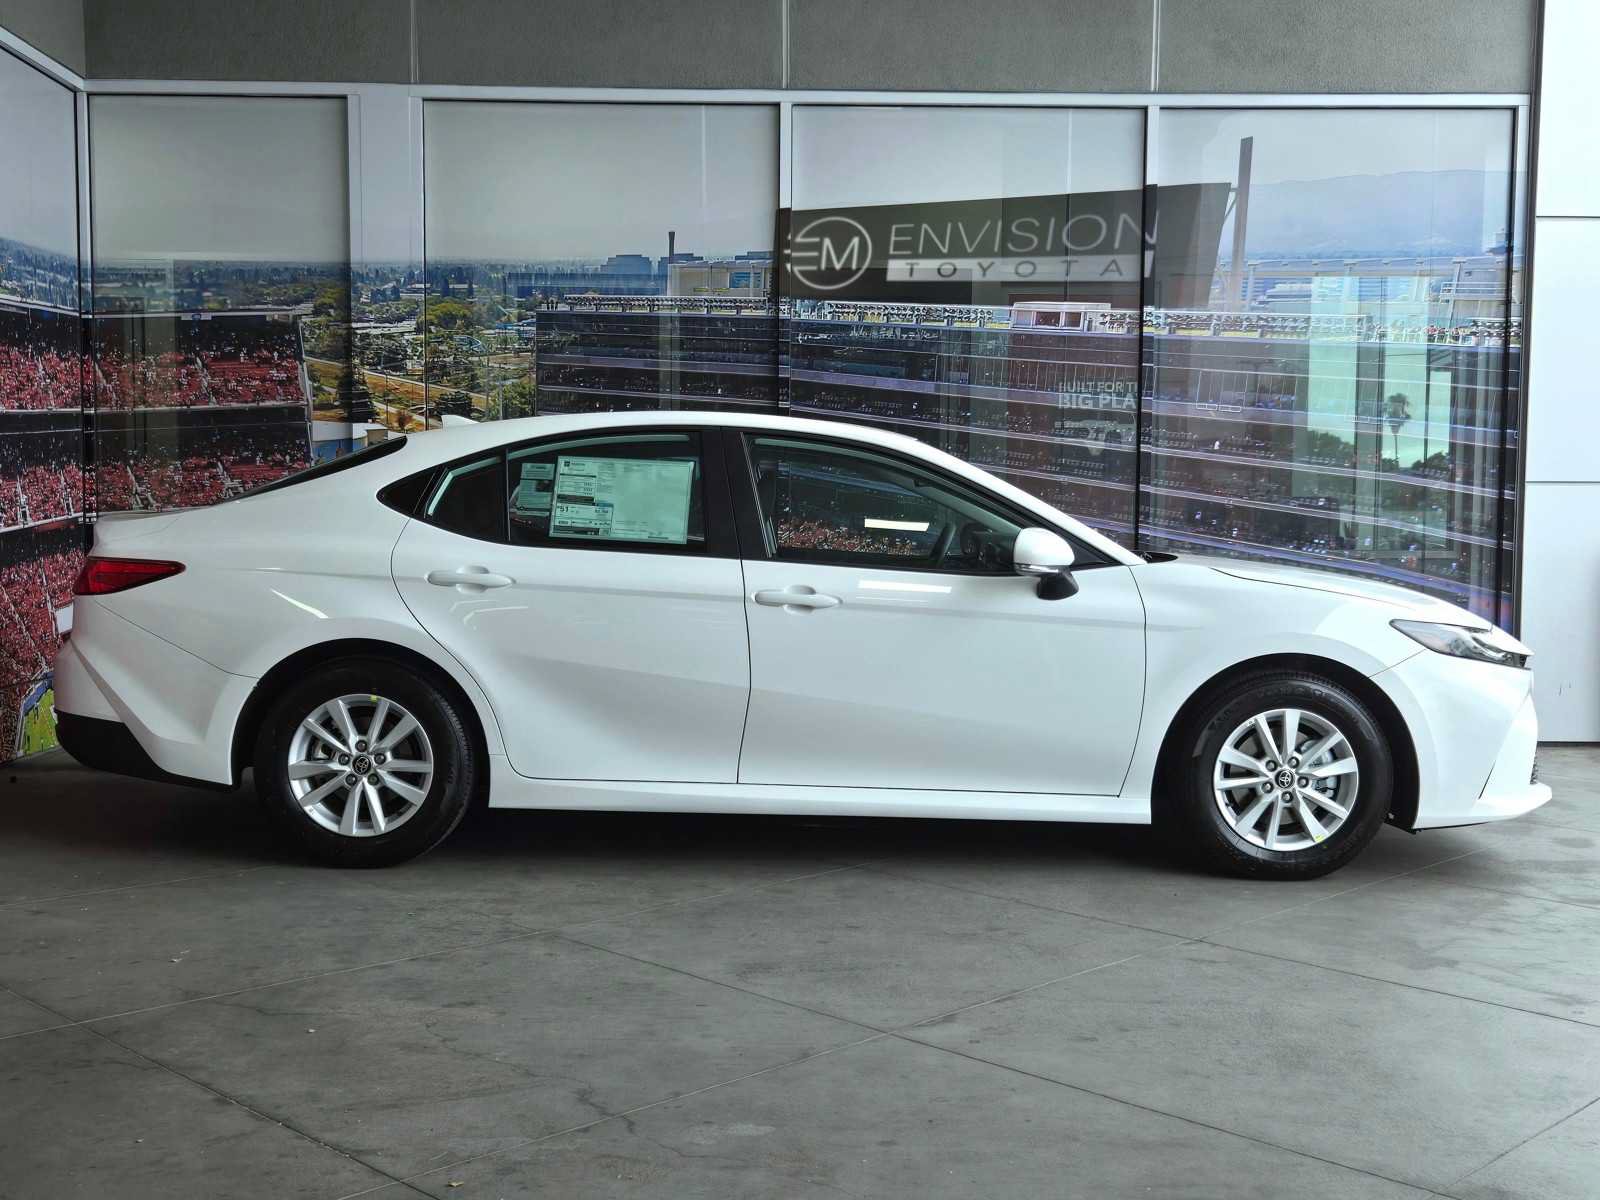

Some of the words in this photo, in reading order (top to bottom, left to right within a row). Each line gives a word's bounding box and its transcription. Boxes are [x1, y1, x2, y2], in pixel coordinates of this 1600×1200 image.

[889, 208, 1159, 255] ENVISION
[905, 258, 1123, 278] TOYOTA
[1097, 381, 1124, 393] FOR
[1058, 393, 1093, 409] BIG
